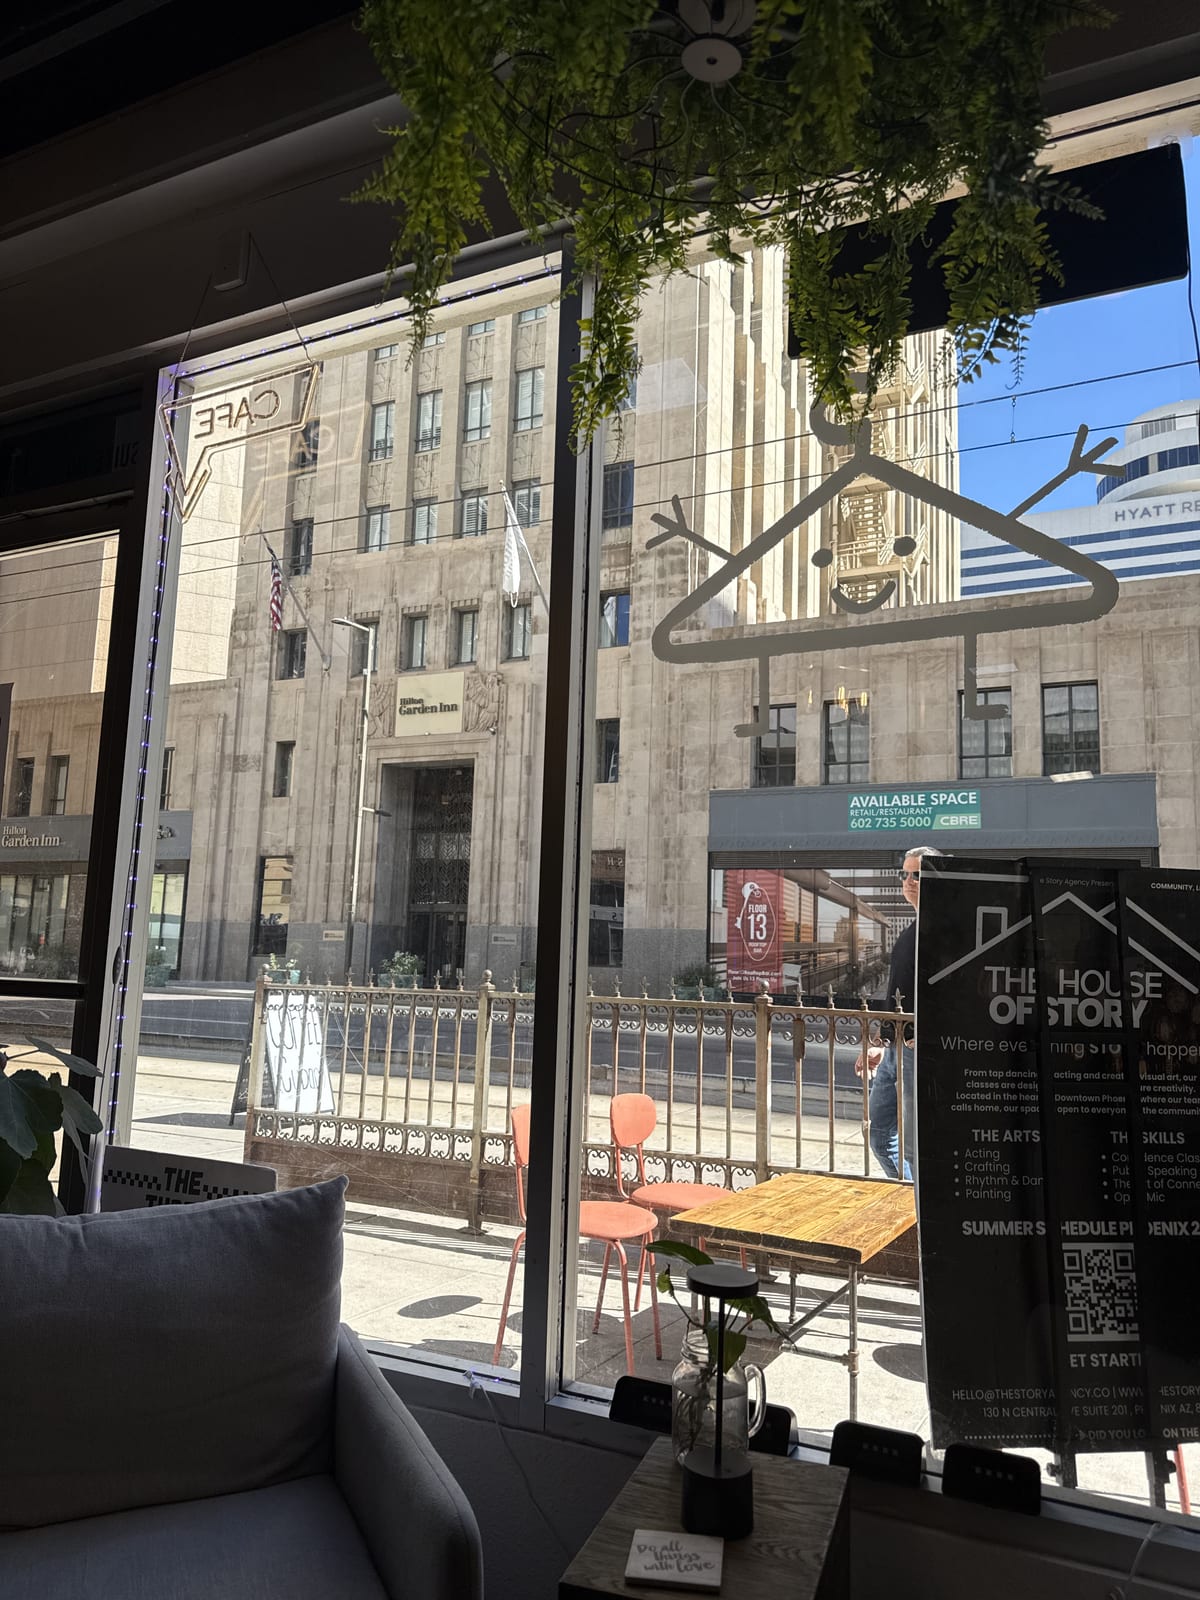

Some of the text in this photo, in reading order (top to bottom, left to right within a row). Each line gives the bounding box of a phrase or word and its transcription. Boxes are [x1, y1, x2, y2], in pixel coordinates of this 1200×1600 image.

[1115, 503, 1176, 522] HYATT
[400, 697, 424, 705] Hilton
[399, 702, 458, 715] Garden Inn
[850, 792, 977, 808] AVAILABLE SPACE
[850, 807, 933, 817] RETAIL/RESTAURANT
[851, 816, 931, 829] 602 735 5000
[940, 815, 978, 826] CBRE
[3, 825, 26, 835] Hilton
[1, 834, 60, 848] Garden Inn
[748, 904, 767, 913] FLOOR
[747, 914, 767, 940] 13
[984, 966, 1036, 994] THE
[989, 995, 1035, 1025] OF
[940, 1036, 994, 1052] Where
[964, 1068, 987, 1078] From
[989, 1069, 1003, 1080] tap
[1053, 1070, 1081, 1081] acting
[1083, 1071, 1100, 1080] and
[1167, 1073, 1181, 1083] art,
[966, 1081, 999, 1090] classes
[1001, 1082, 1015, 1090] are
[1153, 1084, 1197, 1095] creativity.
[956, 1091, 991, 1101] Located
[993, 1092, 1001, 1101] in
[1003, 1092, 1017, 1101] the
[1054, 1093, 1100, 1103] Downtown
[951, 1103, 972, 1112] calls
[973, 1103, 1002, 1113] home,
[1003, 1105, 1018, 1113] our
[1057, 1106, 1079, 1117] open
[1081, 1106, 1089, 1114] to
[1142, 1106, 1157, 1115] the
[972, 1130, 1040, 1143] THE ARTS
[1142, 1131, 1185, 1144] SKILLS
[965, 1148, 1000, 1161] Acting
[965, 1162, 1010, 1175] Crafting
[1147, 1165, 1197, 1179] Speaking
[164, 1167, 203, 1195] THE
[965, 1175, 1008, 1188] Rhythm
[1011, 1176, 1019, 1186] &
[965, 1188, 1011, 1202] Painting
[1146, 1192, 1166, 1203] Mic
[962, 1221, 1032, 1236] SUMMER
[983, 1406, 999, 1418] 130
[1002, 1407, 1010, 1417] N
[1082, 1404, 1109, 1416] SUITE
[1163, 1427, 1179, 1438] ON
[1180, 1427, 1199, 1437] THE
[637, 1540, 682, 1554] Do all
[654, 1551, 701, 1562] things
[644, 1559, 715, 1573] with love
